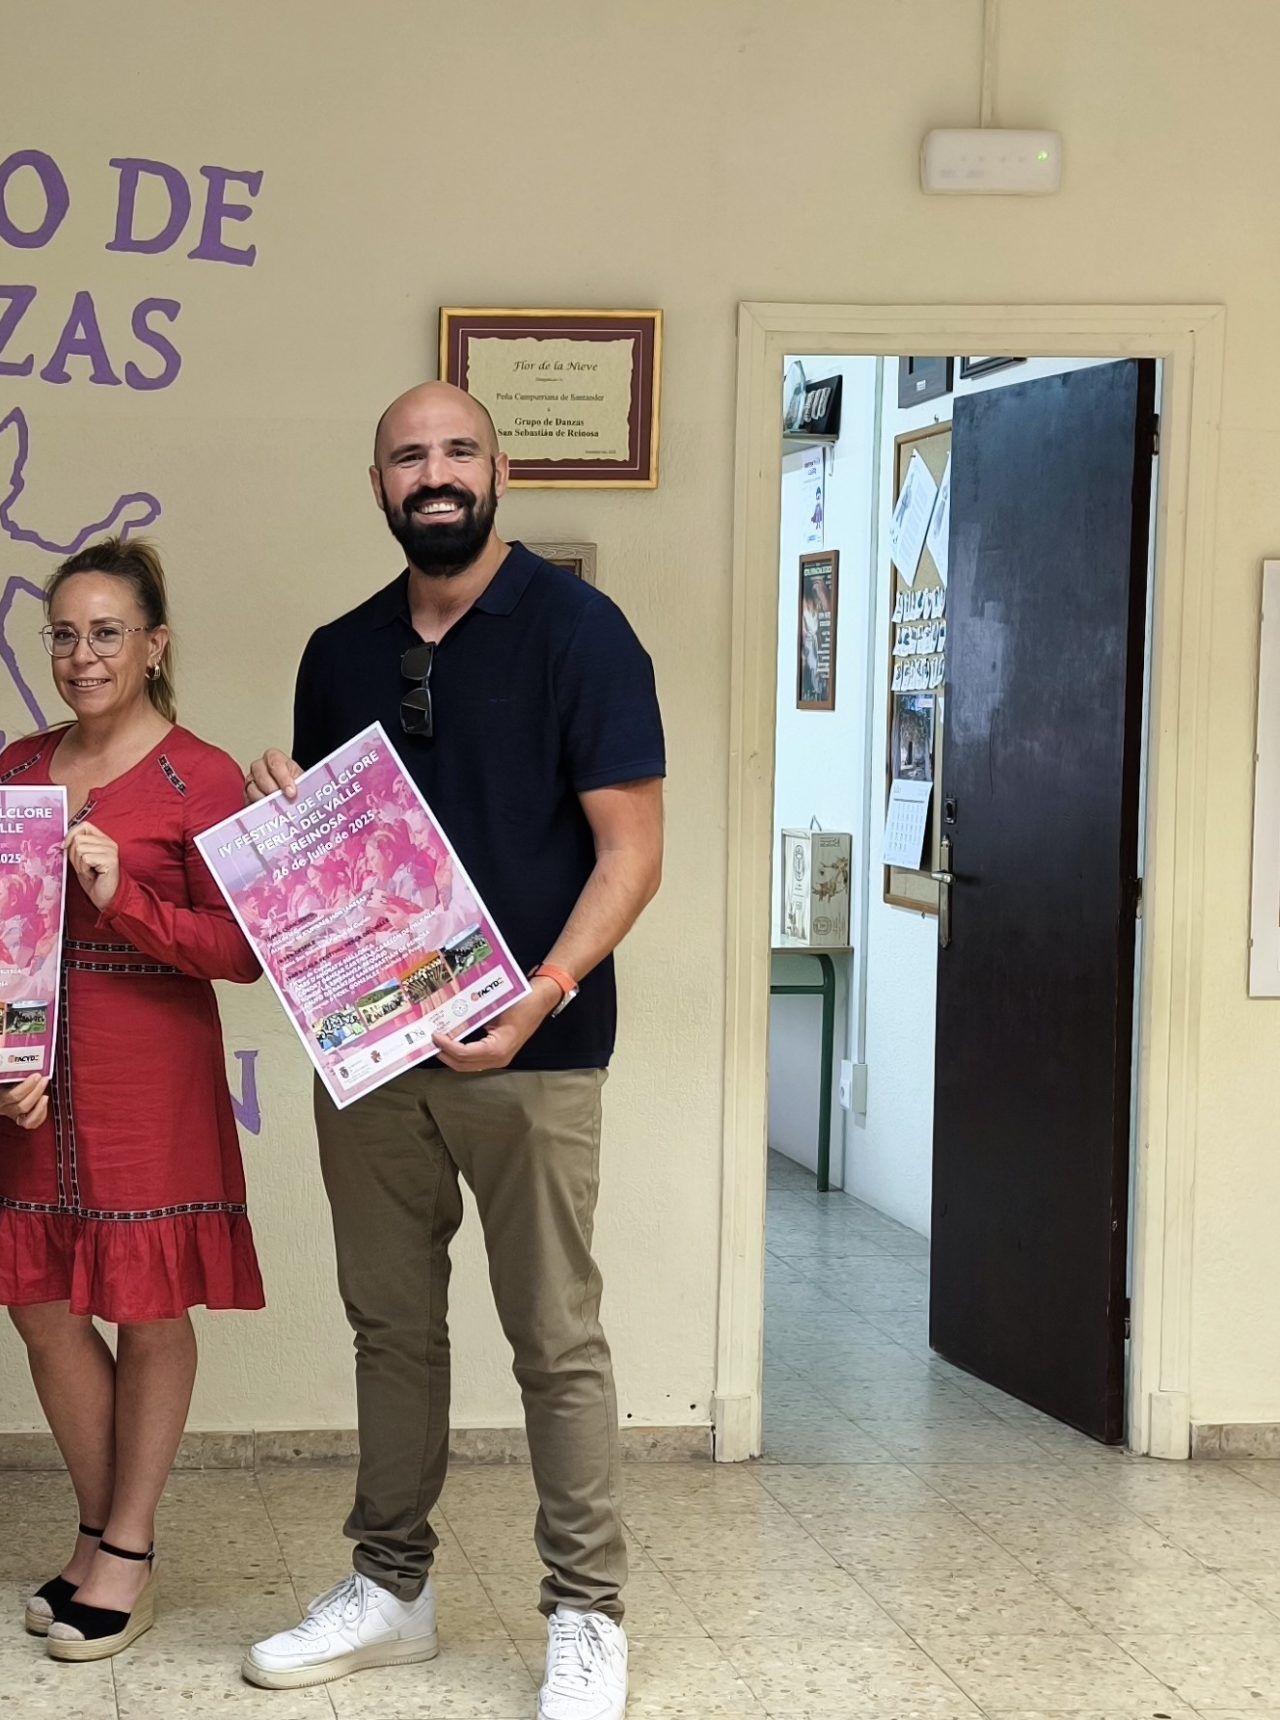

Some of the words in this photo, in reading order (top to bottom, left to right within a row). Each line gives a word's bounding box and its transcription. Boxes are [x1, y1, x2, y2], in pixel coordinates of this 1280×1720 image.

[105, 158, 264, 267] DE
[513, 360, 534, 372] Flor
[538, 360, 551, 371] de
[554, 360, 564, 371] la
[567, 361, 598, 372] Nieve
[560, 393, 569, 401] de
[497, 429, 513, 437] San
[514, 428, 554, 437] Sebastián
[555, 429, 565, 437] de
[567, 429, 599, 438] Reinosa
[515, 417, 541, 428] Grupo
[543, 418, 553, 426] de
[555, 418, 585, 426] Danzas
[218, 842, 232, 858] IV
[235, 812, 296, 849] FESTIVAL
[296, 797, 315, 813] DE
[315, 750, 380, 801] FOLCLORE
[256, 826, 300, 854] PERLA
[300, 811, 326, 830] DEL
[324, 781, 363, 812] VALLE
[274, 867, 289, 880] 26
[292, 857, 306, 871] de
[307, 841, 333, 864] Julio
[334, 831, 348, 844] de
[348, 810, 375, 834] 2025
[290, 813, 347, 853] REINOSA
